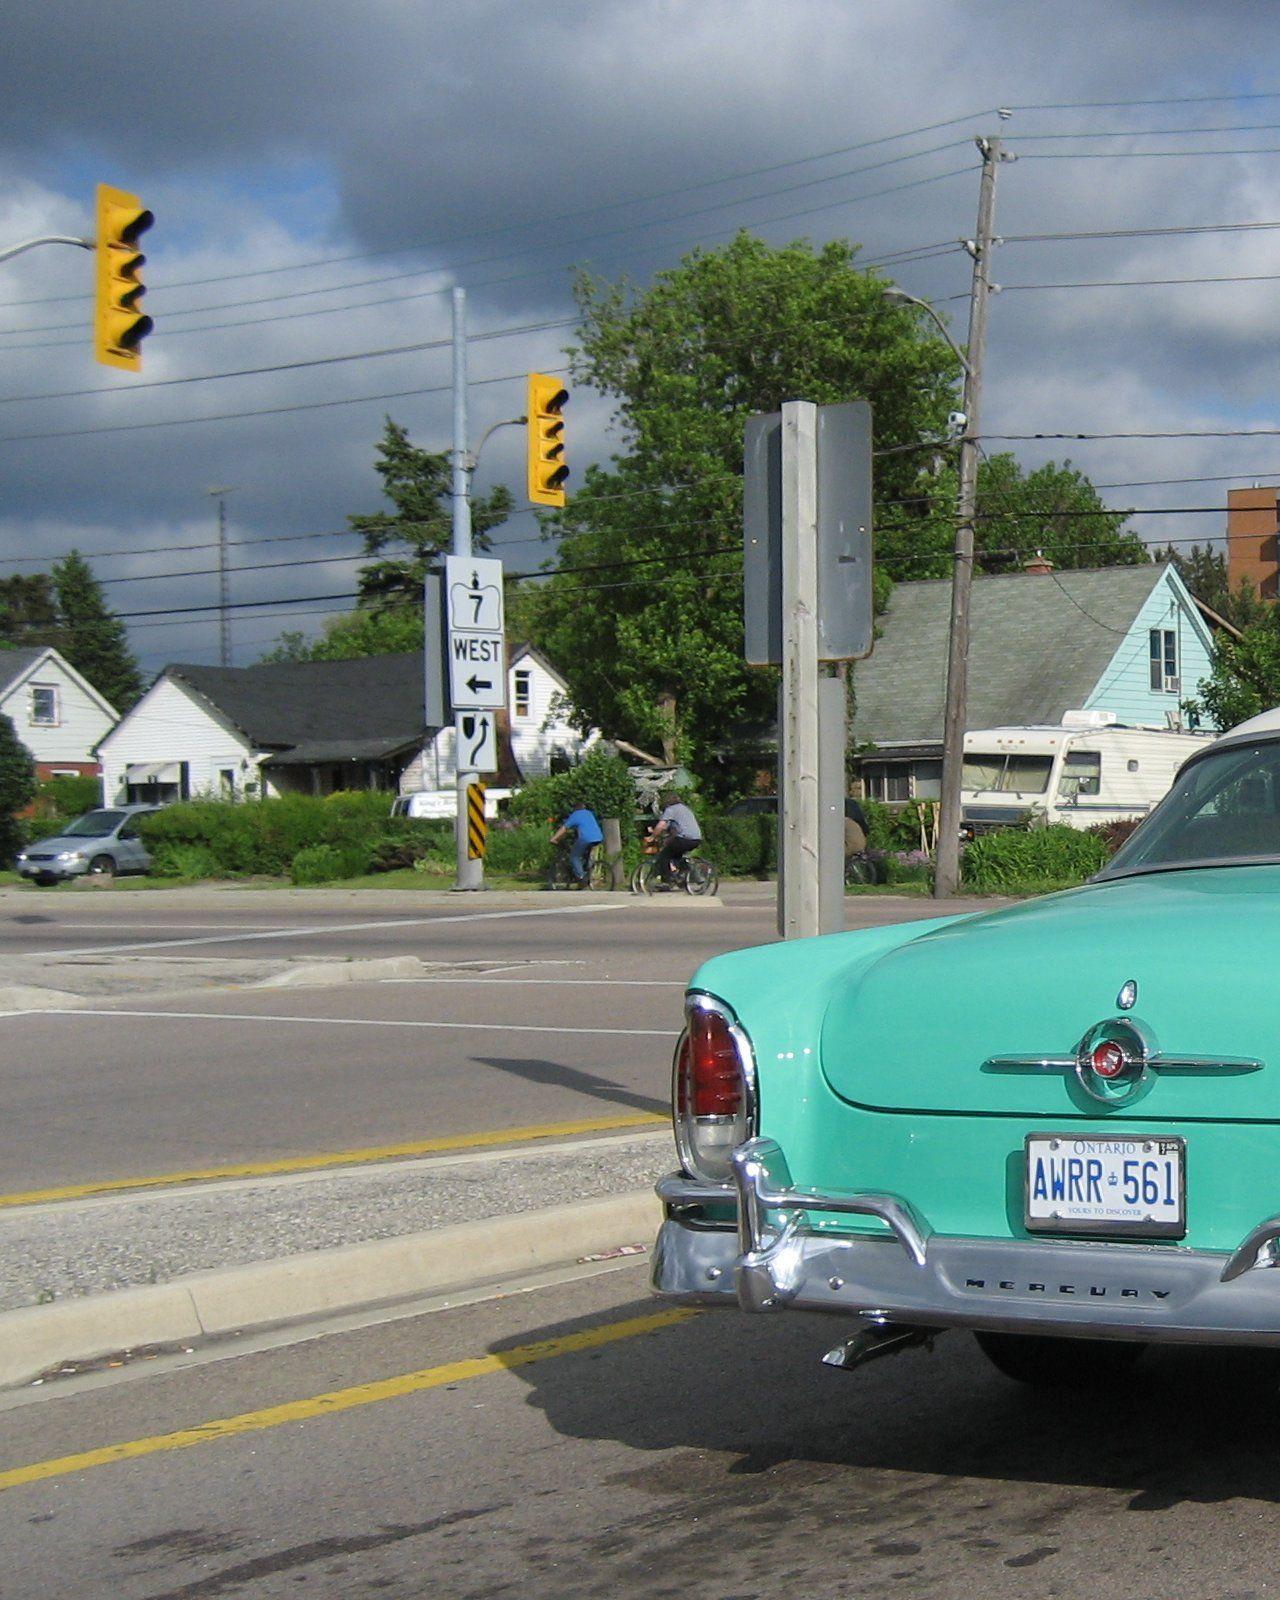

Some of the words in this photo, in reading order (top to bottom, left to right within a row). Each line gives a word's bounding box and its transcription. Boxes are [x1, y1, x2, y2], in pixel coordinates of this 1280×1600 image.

[468, 594, 483, 624] 7
[454, 637, 500, 662] WEST
[1073, 1141, 1136, 1155] ONTARIO
[1033, 1157, 1102, 1203] AWRR
[1123, 1161, 1175, 1206] 561
[966, 1279, 1170, 1299] MERCURY
